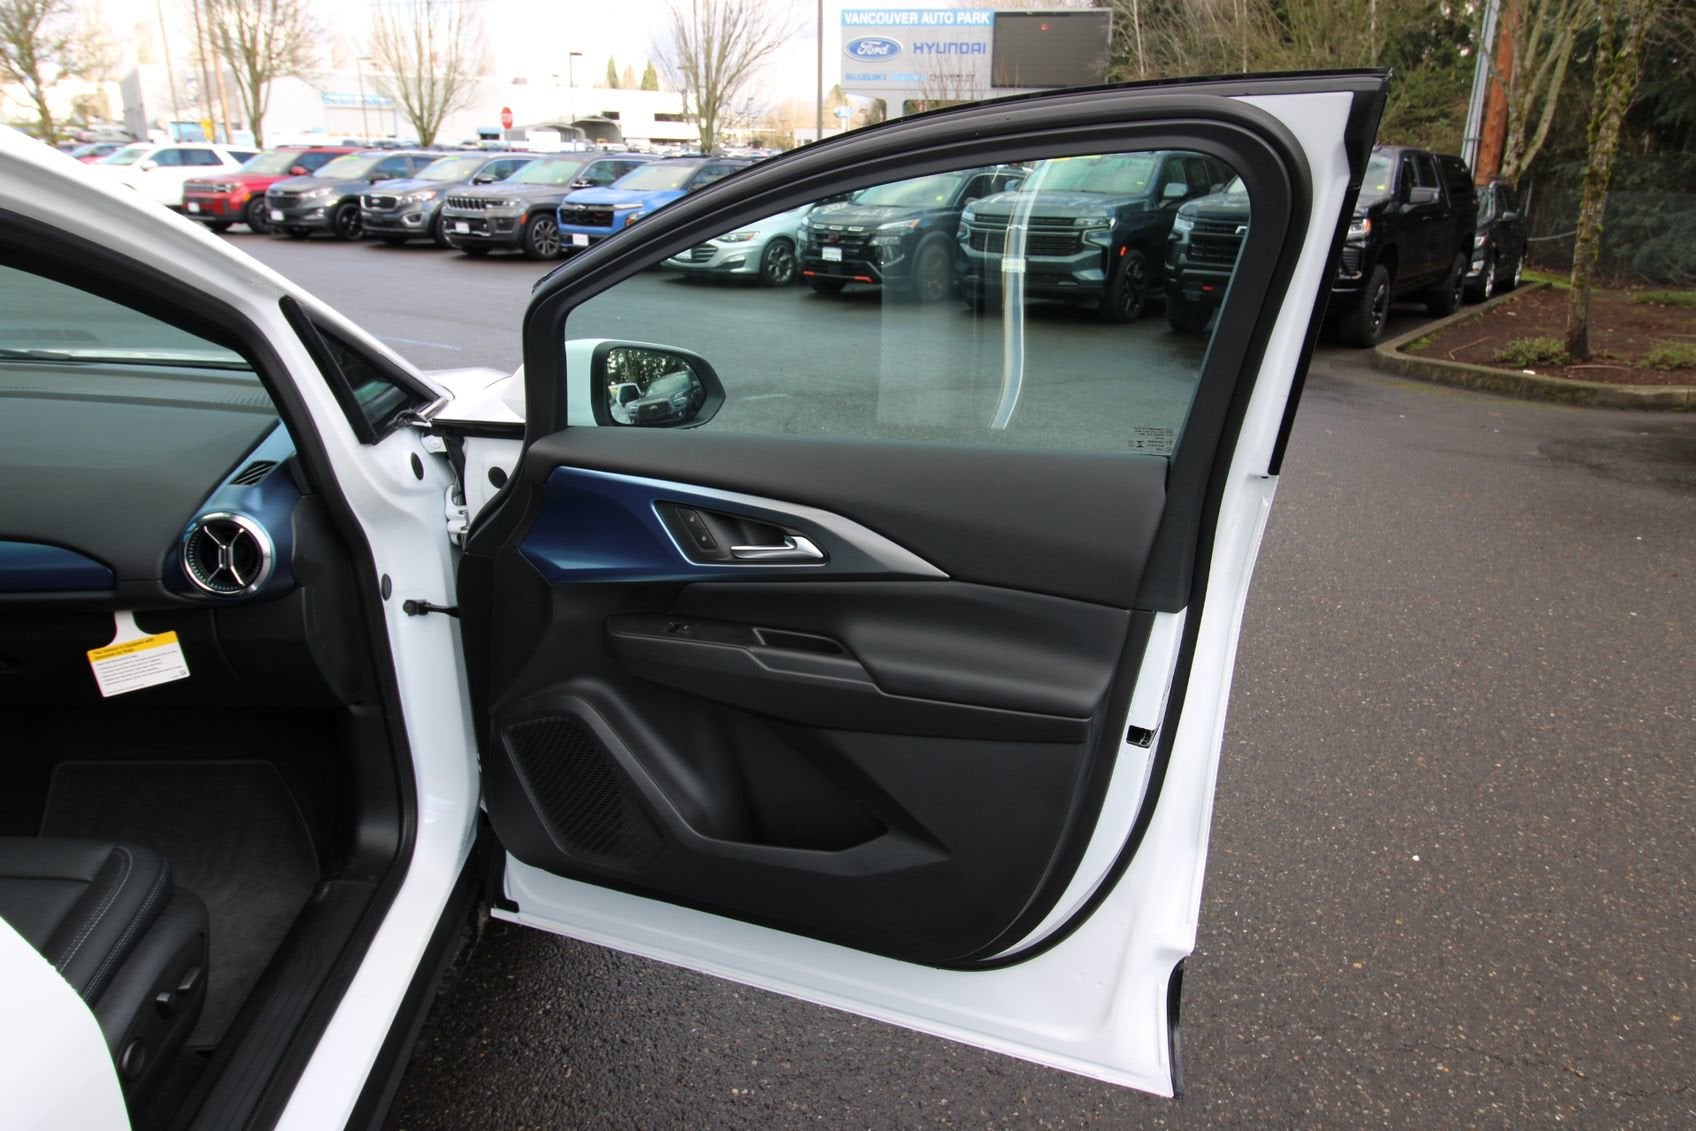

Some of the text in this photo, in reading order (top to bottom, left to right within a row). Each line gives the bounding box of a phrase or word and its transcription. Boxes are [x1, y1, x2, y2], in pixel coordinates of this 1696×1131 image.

[844, 12, 990, 25] VANCOUVER AUTO PARK
[857, 40, 889, 56] Ford
[913, 42, 987, 55] HYUNDAI
